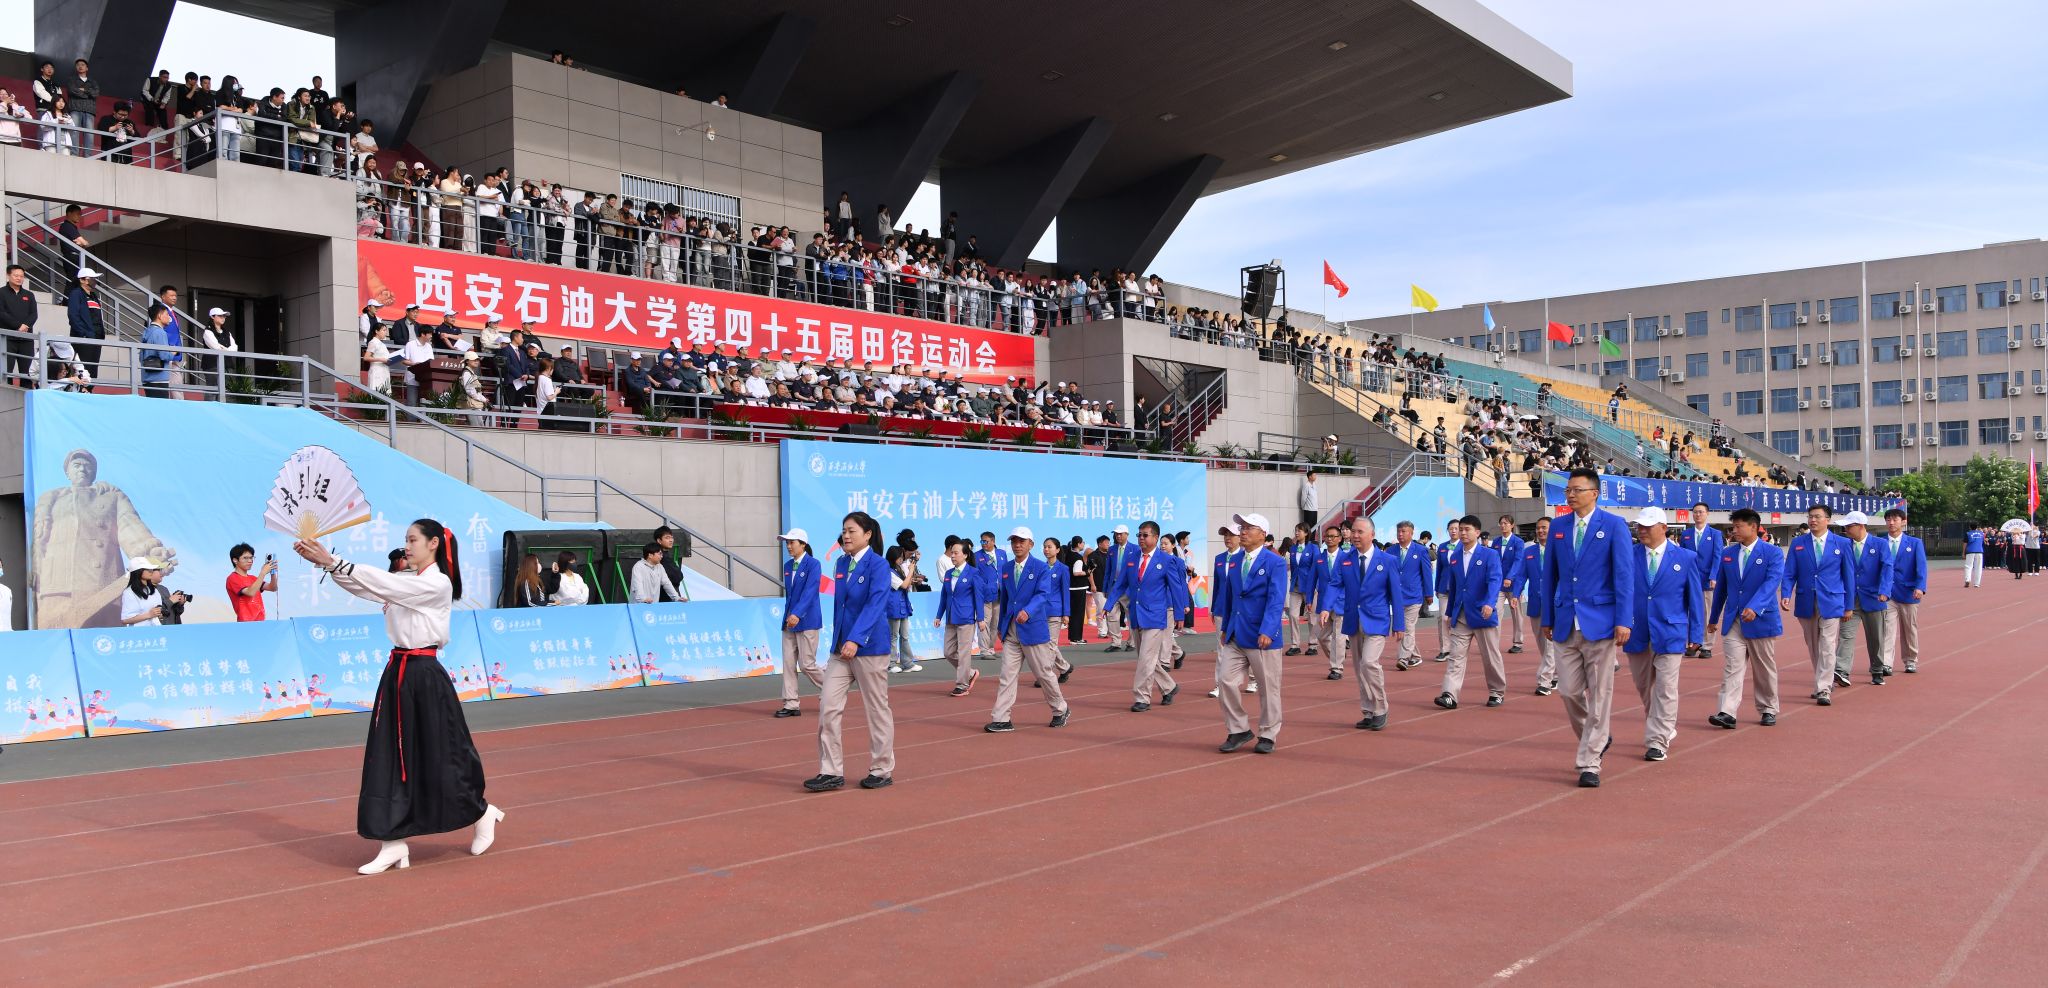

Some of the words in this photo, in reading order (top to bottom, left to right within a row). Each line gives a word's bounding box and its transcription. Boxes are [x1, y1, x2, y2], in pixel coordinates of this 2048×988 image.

[413, 265, 997, 375] 西安石油大学第四十五届田径运动会
[846, 488, 1175, 522] 西安石油大学第四十五届田径运动会
